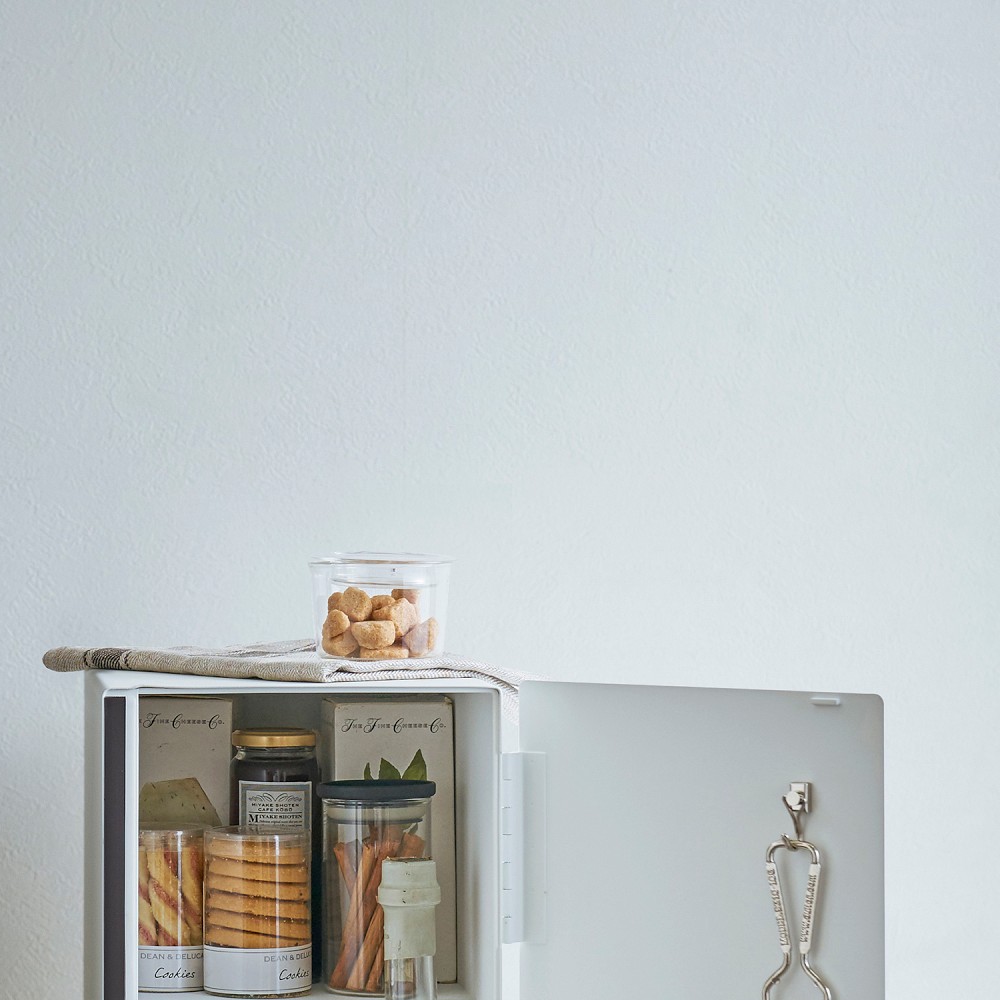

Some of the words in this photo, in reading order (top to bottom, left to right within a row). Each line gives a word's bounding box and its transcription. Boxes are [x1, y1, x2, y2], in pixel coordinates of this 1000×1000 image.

[248, 814, 278, 823] MIYAKE
[154, 967, 195, 978] Cookies
[279, 967, 309, 980] Cookies
